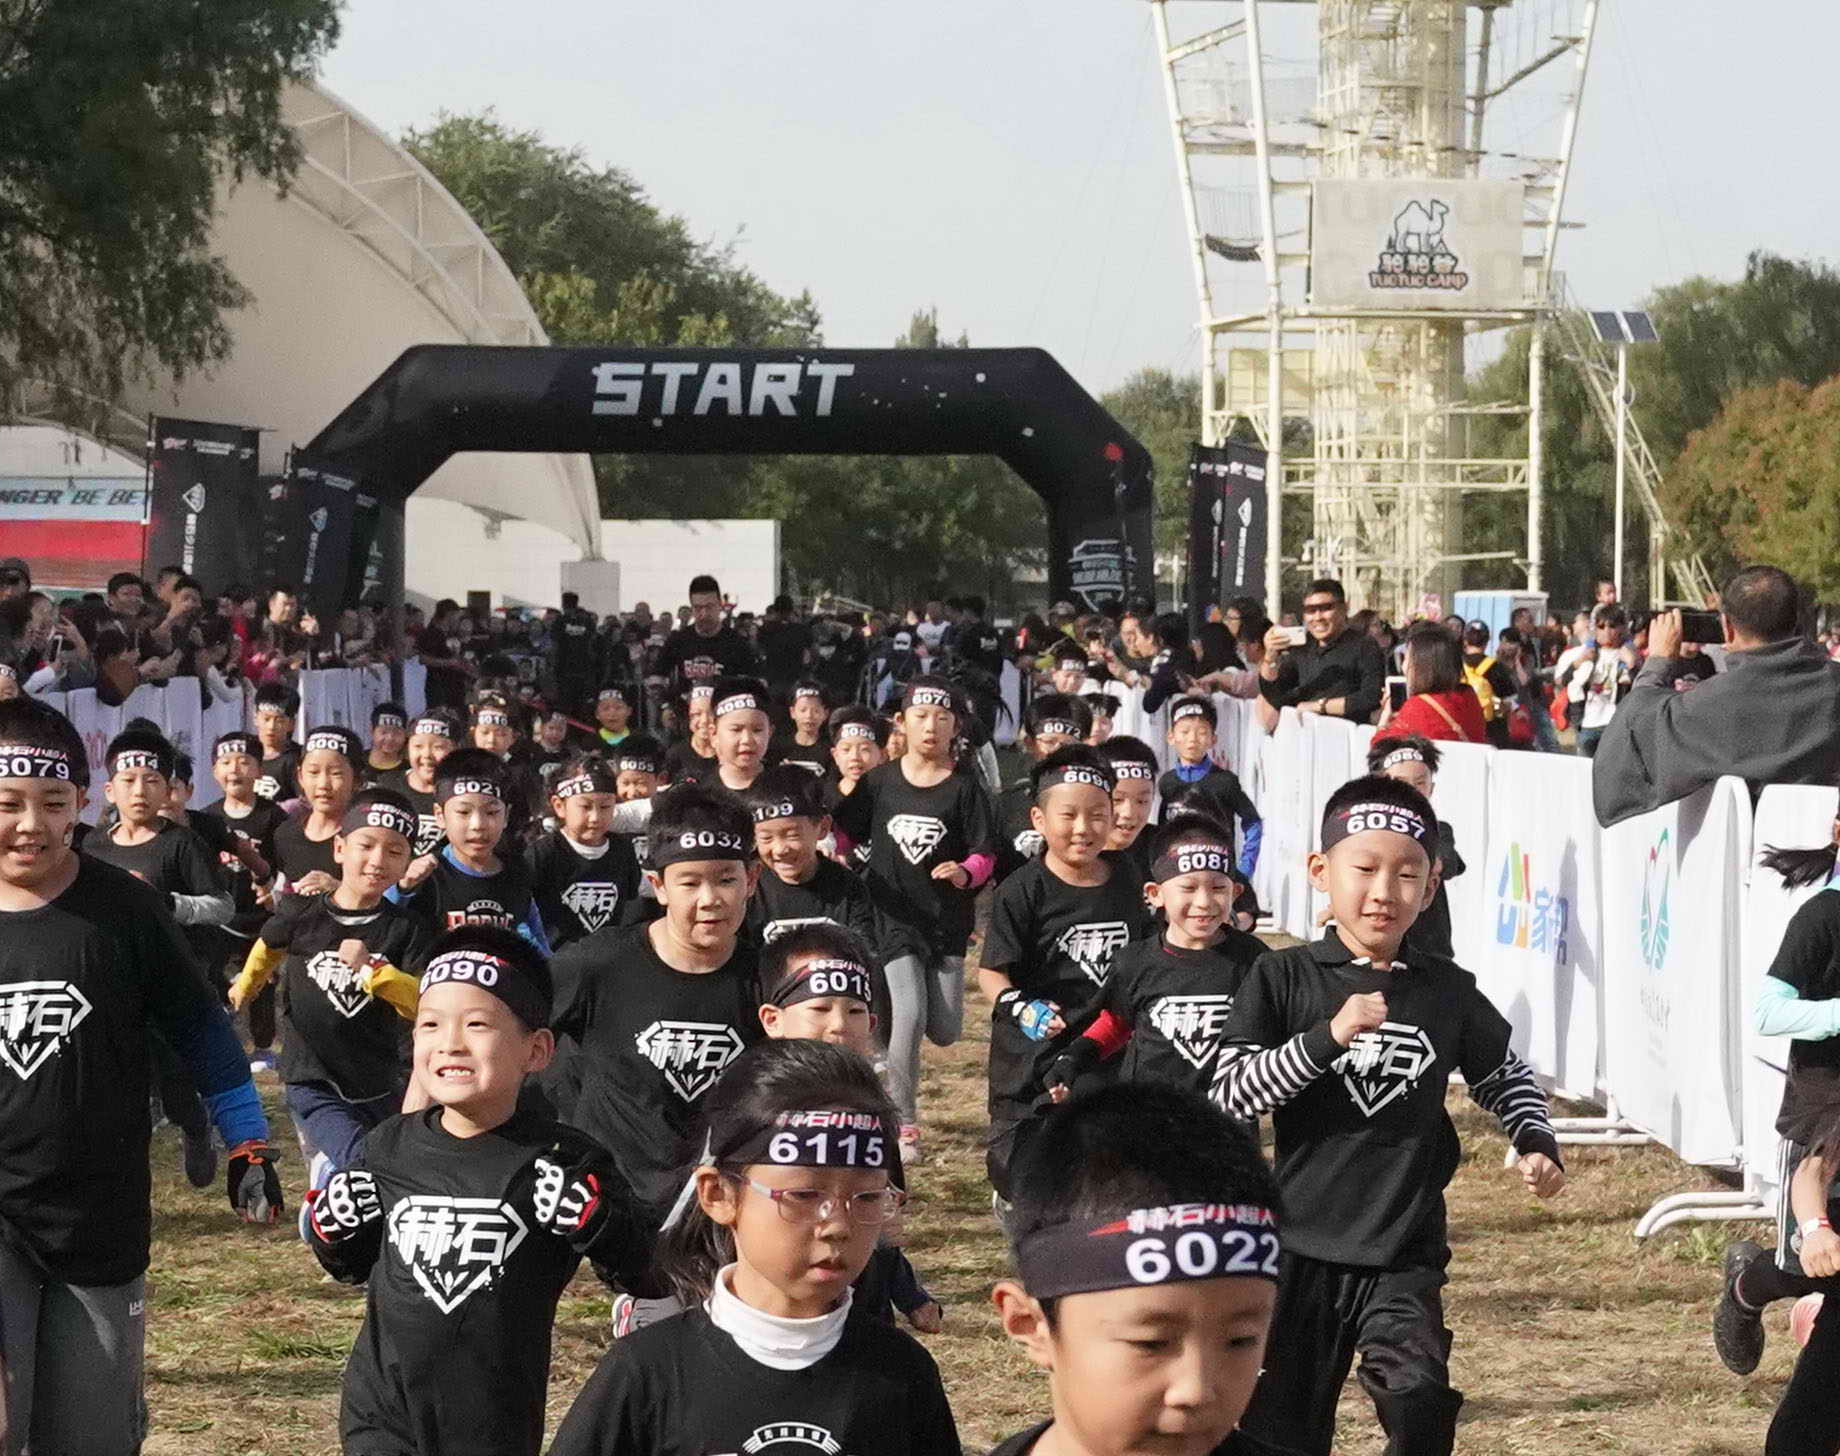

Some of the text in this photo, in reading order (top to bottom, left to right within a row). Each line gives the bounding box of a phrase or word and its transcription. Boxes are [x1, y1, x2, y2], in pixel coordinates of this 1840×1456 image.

[591, 361, 854, 416] START
[107, 489, 145, 506] BE
[1044, 722, 1080, 739] 6072
[306, 737, 347, 754] 6001
[116, 755, 158, 770] 6114
[1116, 766, 1152, 780] 005
[454, 780, 501, 799] 6021
[366, 811, 413, 837] 6017
[1347, 813, 1425, 840] 6057
[680, 831, 741, 850] 6032
[1178, 854, 1228, 873] 6081
[569, 886, 616, 914] 赫石
[420, 961, 498, 994] 6090
[645, 1032, 731, 1069] 赫石
[769, 1132, 884, 1166] 6115
[1127, 1203, 1277, 1232] 赫石小超人
[393, 1207, 507, 1265] 赫石
[1126, 1230, 1278, 1282] 6022
